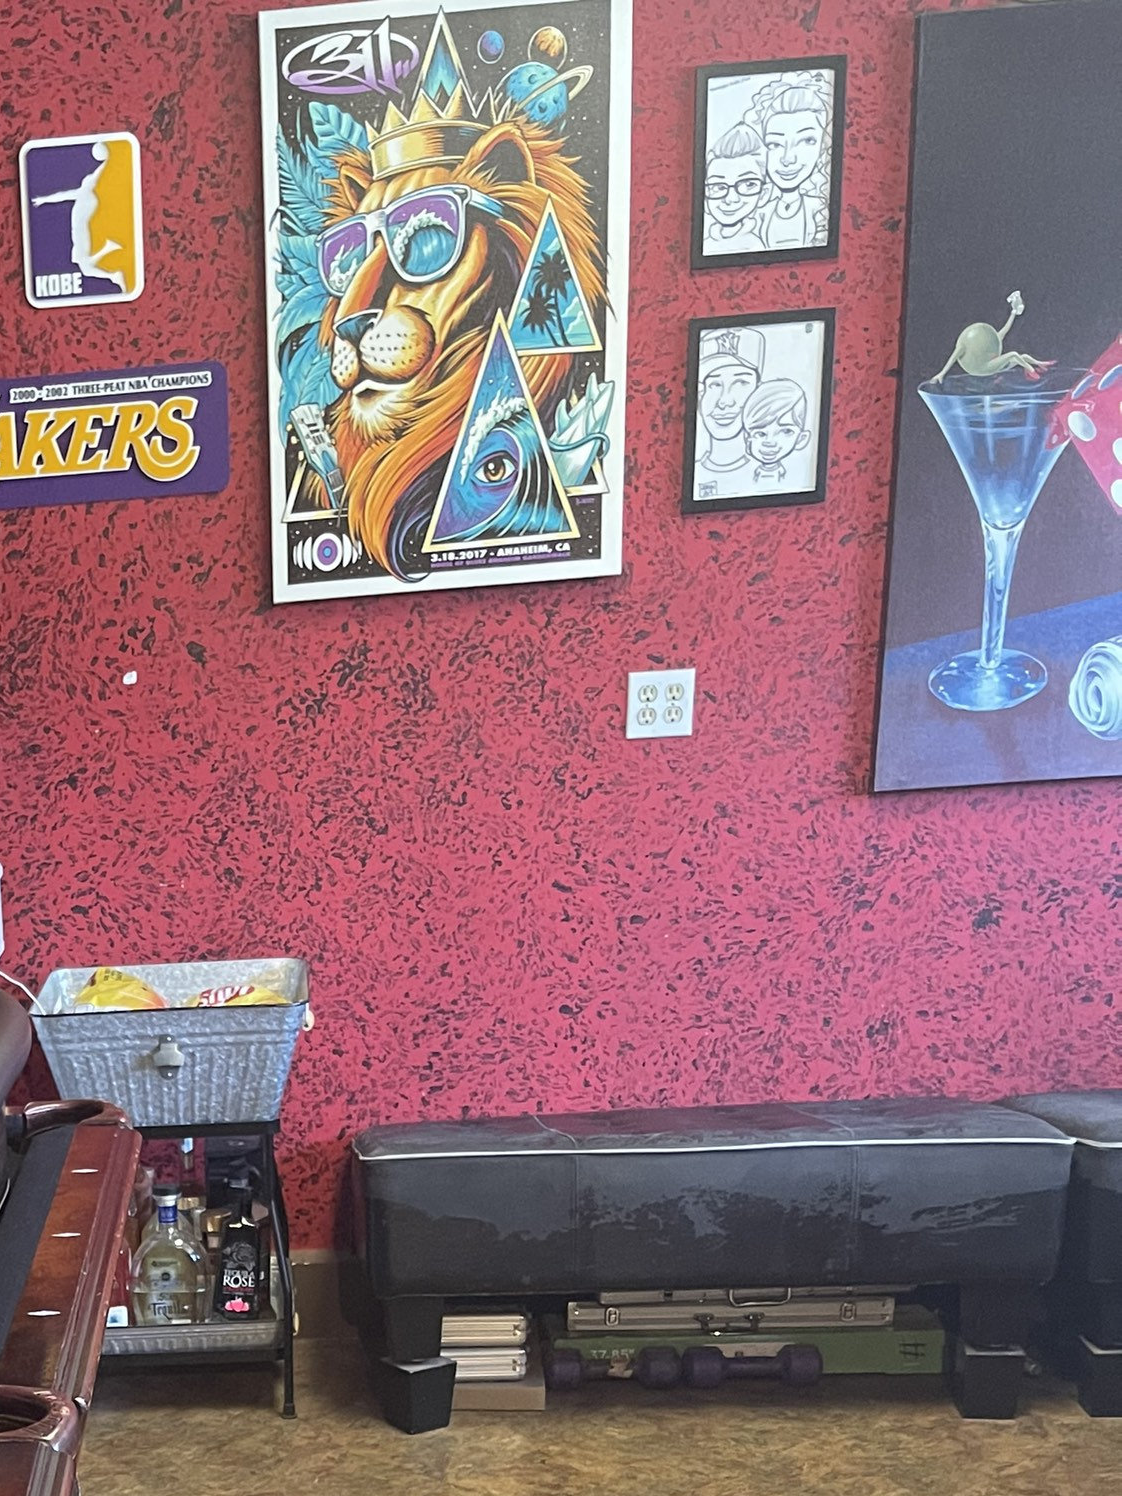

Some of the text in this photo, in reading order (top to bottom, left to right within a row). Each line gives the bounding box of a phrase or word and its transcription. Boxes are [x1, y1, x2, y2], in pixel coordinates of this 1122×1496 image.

[35, 272, 83, 298] KOBE
[13, 389, 36, 401] 2000
[45, 386, 68, 399] 2002
[72, 381, 126, 396] THREE-PEAT
[128, 378, 149, 391] NBA
[151, 373, 209, 389] CHAMPIONS
[430, 549, 487, 562] 3.18.2017
[555, 542, 571, 552] CA
[223, 1275, 256, 1288] ROSE
